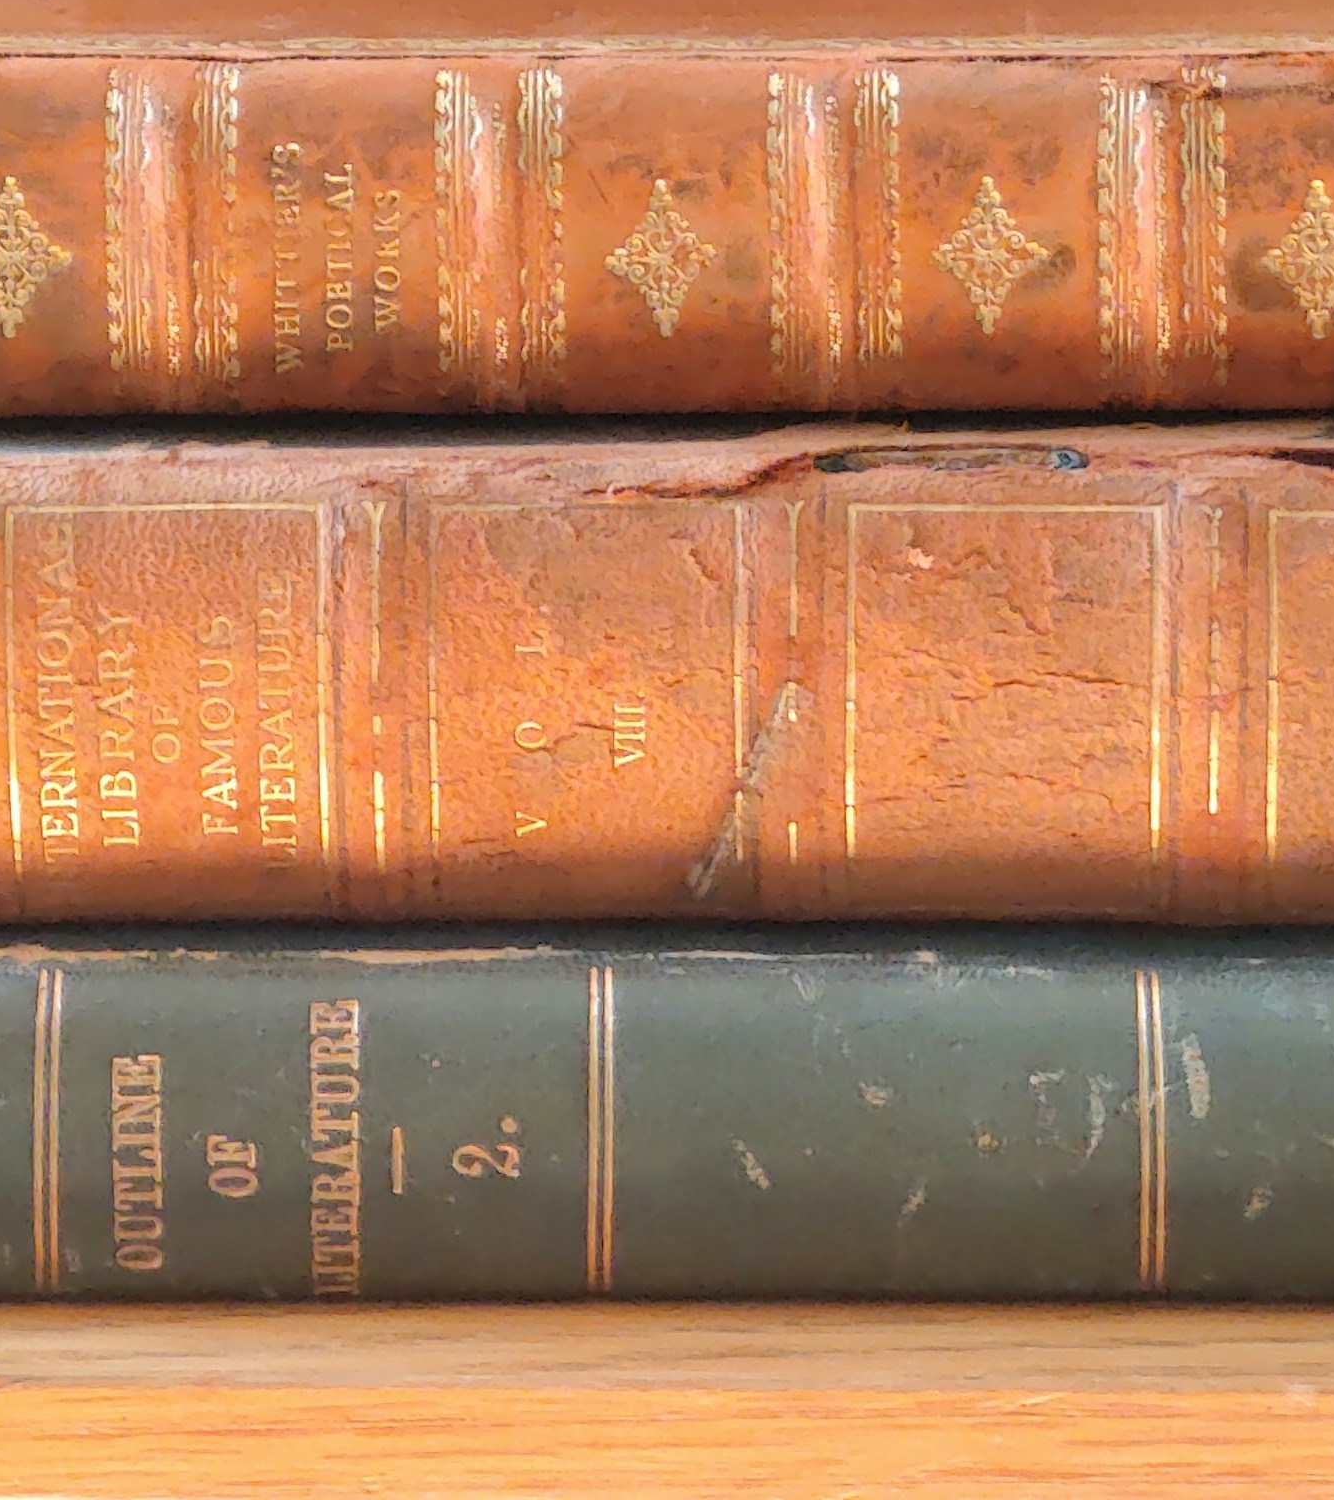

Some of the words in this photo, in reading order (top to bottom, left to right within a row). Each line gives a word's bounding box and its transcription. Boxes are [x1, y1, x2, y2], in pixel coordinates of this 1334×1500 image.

[271, 141, 304, 374] WHITTER'S
[374, 189, 402, 332] WORKS
[96, 600, 141, 848] LIBRARY
[150, 704, 181, 765] OF
[198, 615, 239, 837] FAMOUS
[110, 1053, 165, 1270] OUTLINE
[207, 1133, 260, 1198] OF
[310, 998, 361, 1296] LITERATURE
